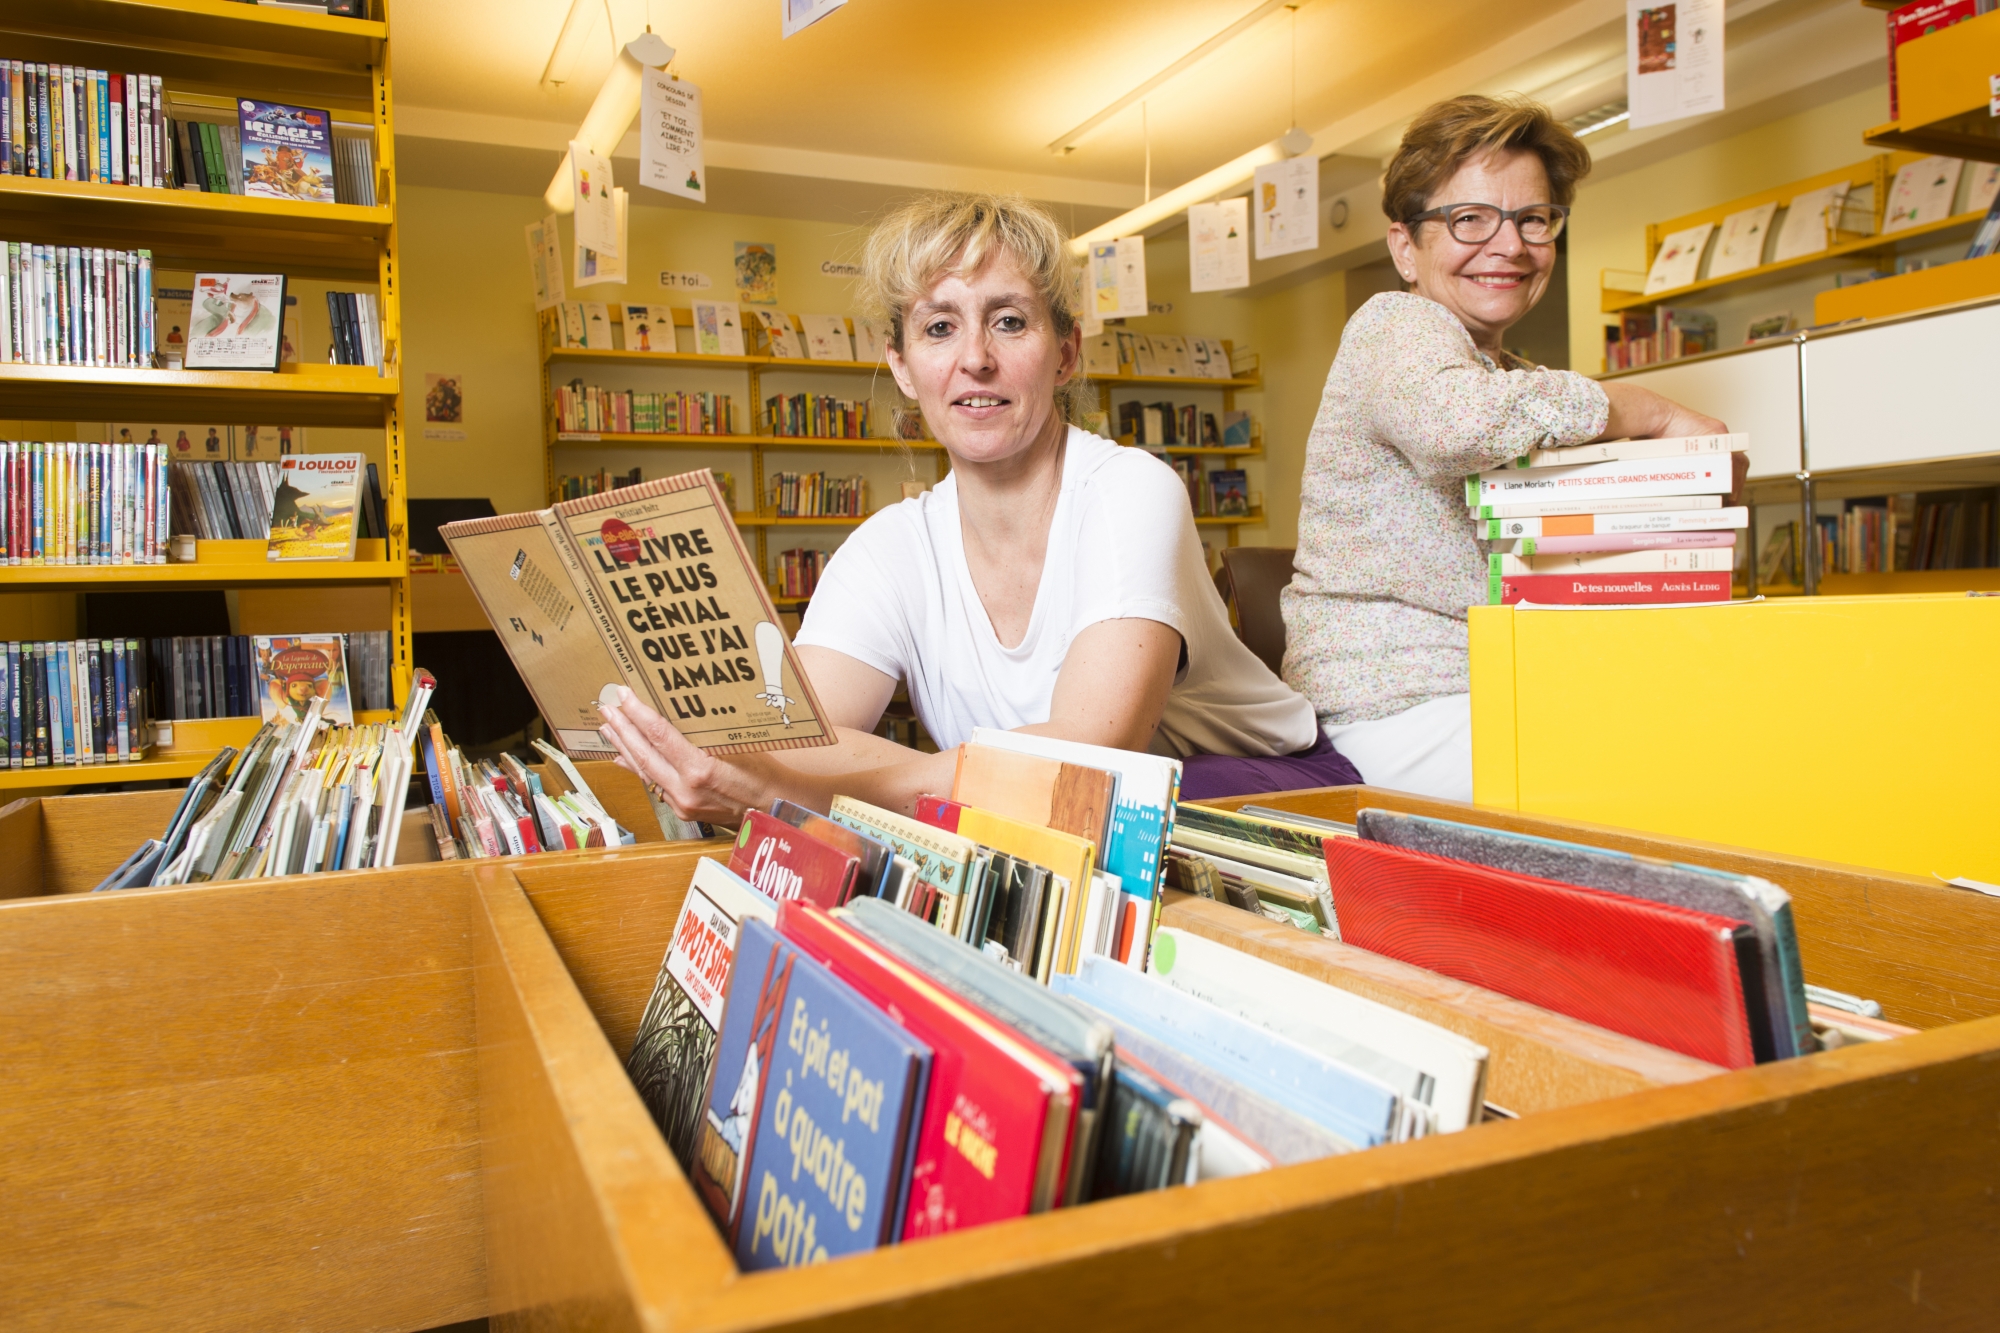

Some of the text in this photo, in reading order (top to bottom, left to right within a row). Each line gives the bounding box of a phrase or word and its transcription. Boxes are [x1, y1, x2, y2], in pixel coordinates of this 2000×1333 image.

[657, 82, 685, 98] CONCOURS
[665, 95, 686, 108] DESSIN
[29, 96, 38, 134] CONCERT
[39, 81, 49, 152] CONTES TERREMER
[245, 120, 324, 140] ICE AGE 5
[257, 132, 289, 141] COLLISION
[661, 121, 694, 138] COMMENT
[660, 131, 695, 148] AIMES-TU
[666, 142, 681, 153] LIRE
[660, 272, 709, 287] Et toi...
[299, 460, 356, 470] LOULOU
[90, 467, 100, 502] LASSIE
[1504, 472, 1696, 490] Liane Moriarty PETITS SECRETS, GRANDS MENSONGES
[615, 503, 660, 519] Christian Voltz
[555, 529, 579, 570] Christian Voltz
[636, 528, 714, 567] LIVRE
[610, 576, 646, 604] LE
[645, 562, 718, 597] PLUS
[1573, 581, 1720, 593] De tes nouvelles AGNÈS LEDIG
[509, 617, 528, 632] FI
[599, 614, 611, 633] PLUS
[626, 596, 730, 634] GÉNIAL
[531, 629, 544, 647] N
[609, 631, 618, 642] LE
[642, 625, 749, 663] QUE J'AI
[613, 641, 628, 664] LIVRE
[270, 660, 331, 673] Despereaux
[623, 661, 634, 673] LE
[657, 656, 756, 692] JAMAIS
[670, 694, 706, 719] LU
[436, 742, 451, 793] Rémi Courgeon
[750, 836, 803, 900] Clown
[676, 909, 733, 998] PIPO ET SIFF
[788, 996, 884, 1134] Et pit et pat
[774, 1068, 867, 1232] à quatre
